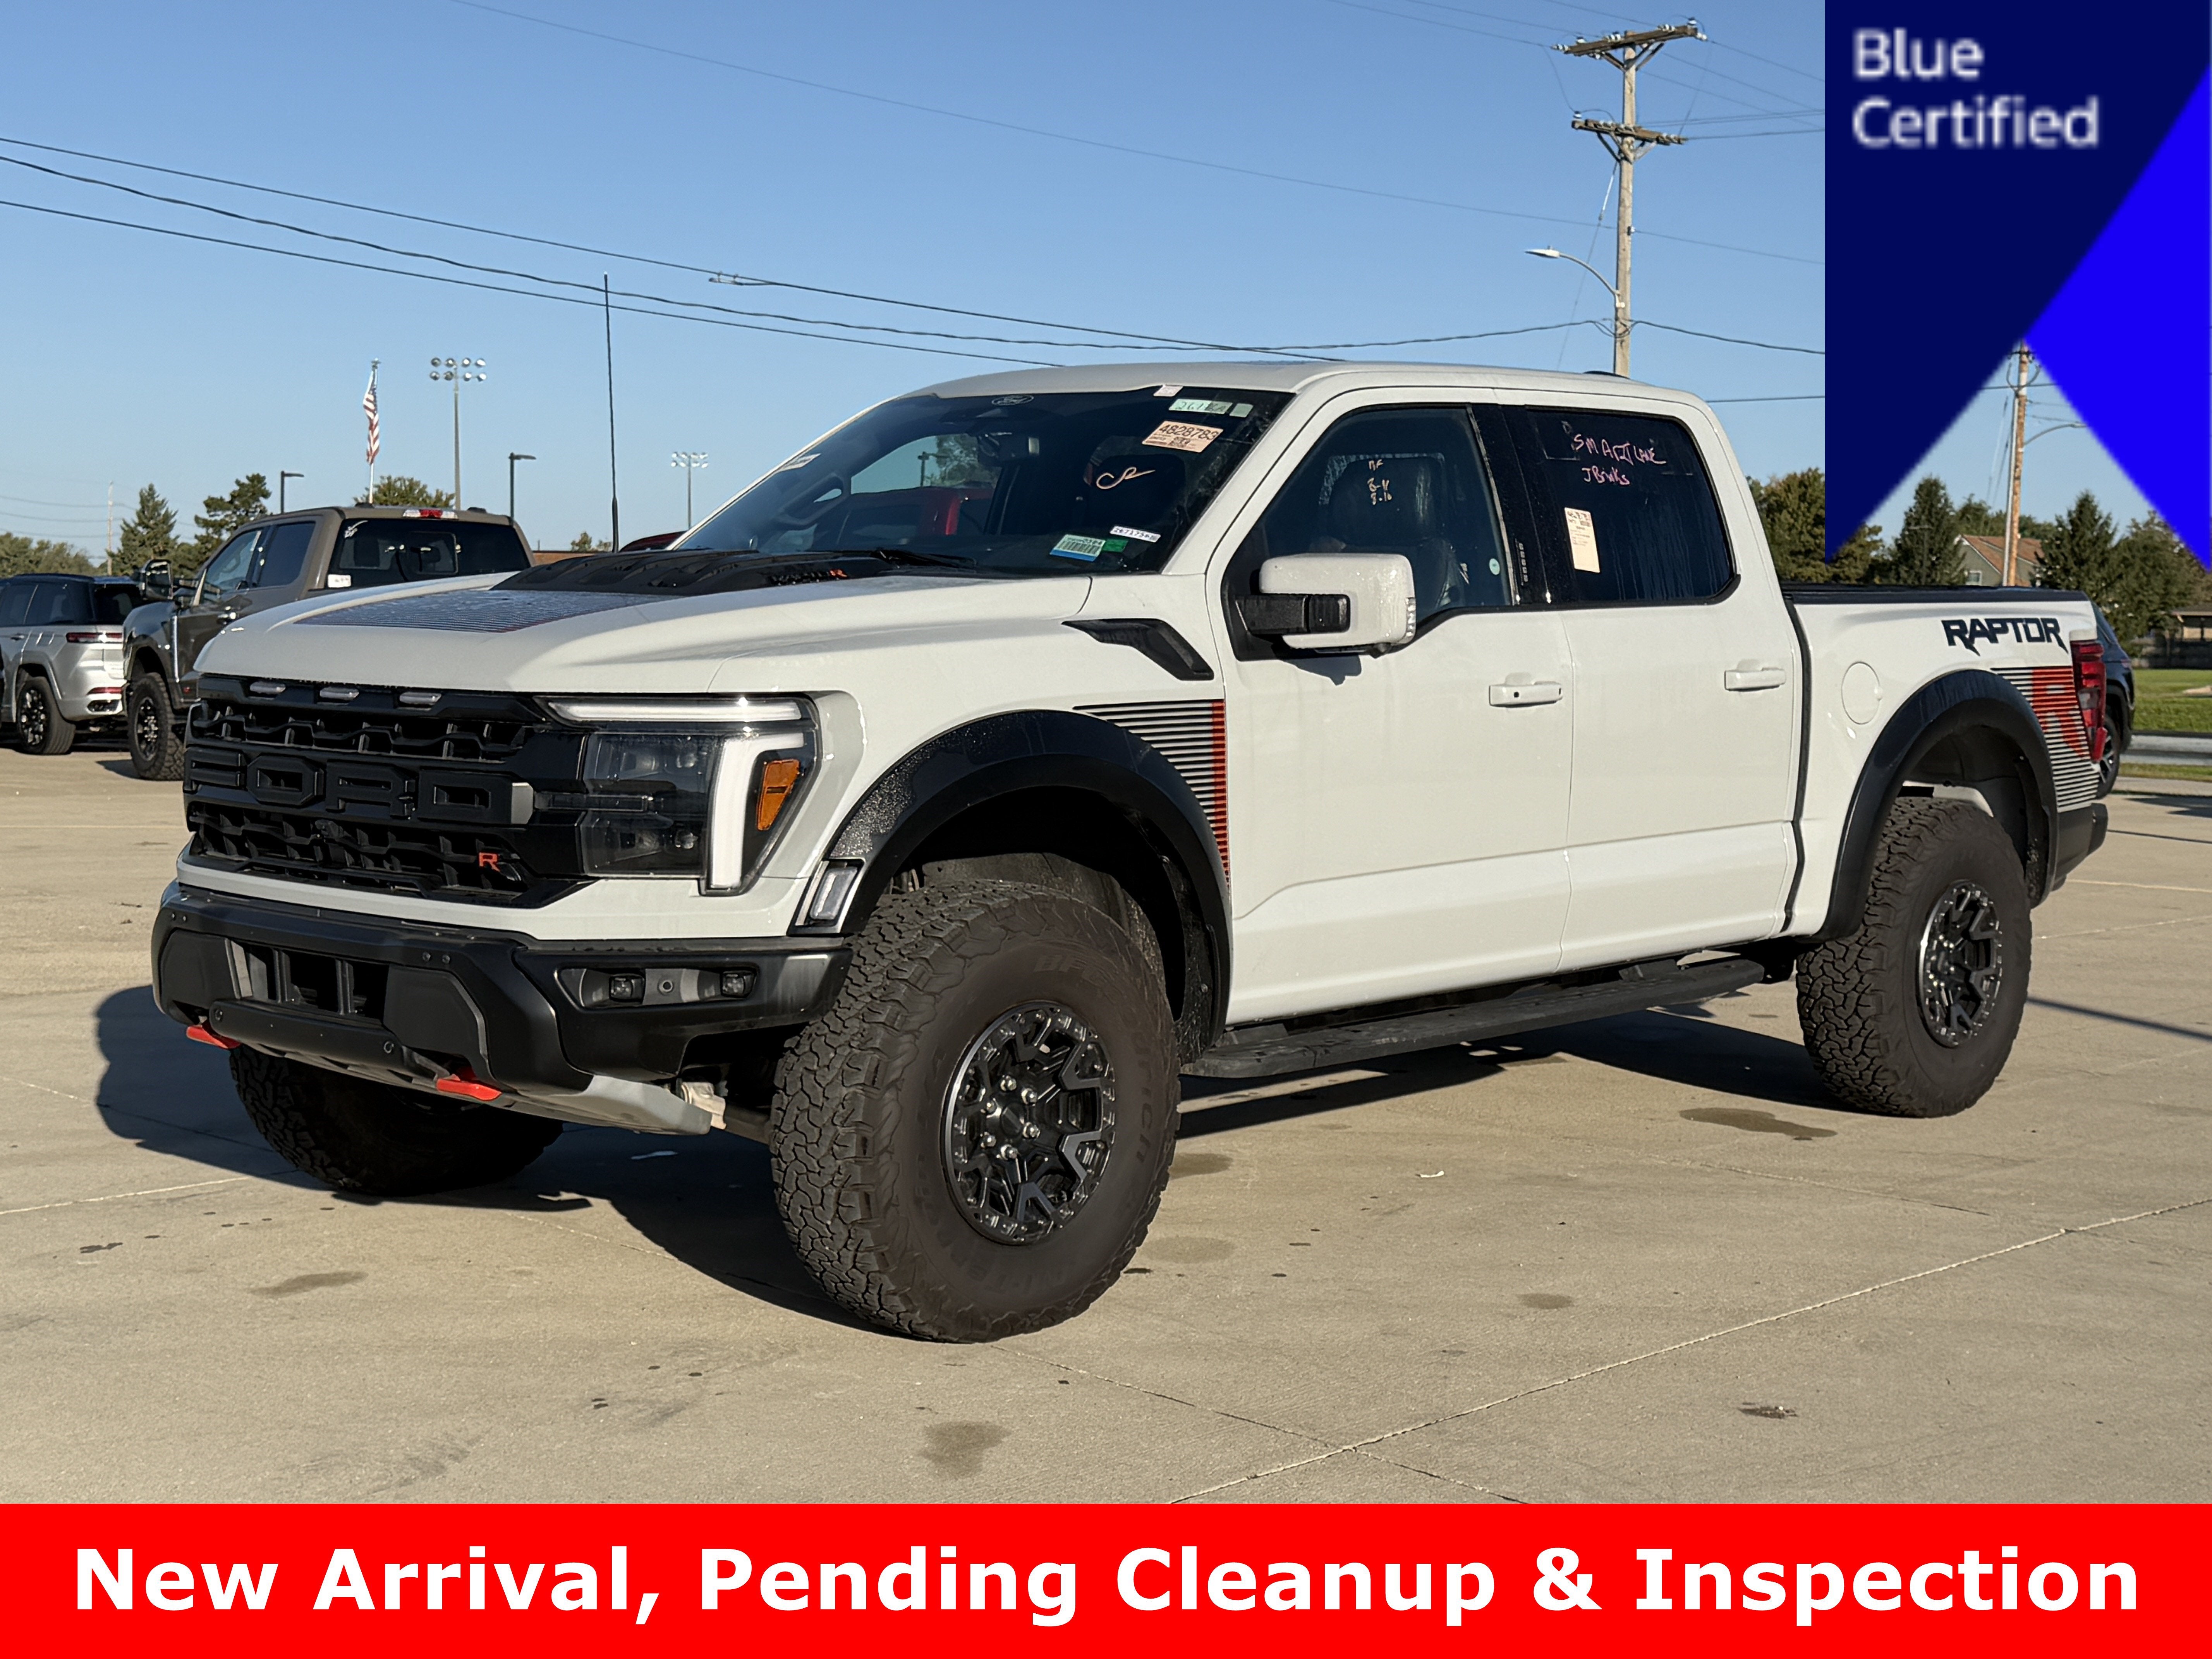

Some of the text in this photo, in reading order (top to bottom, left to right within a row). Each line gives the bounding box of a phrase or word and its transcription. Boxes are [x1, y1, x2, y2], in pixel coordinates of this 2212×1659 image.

[1159, 424, 1219, 440] 4828783
[1941, 618, 2068, 656] RAPTOR
[184, 744, 533, 826] FORD
[479, 852, 501, 872] R
